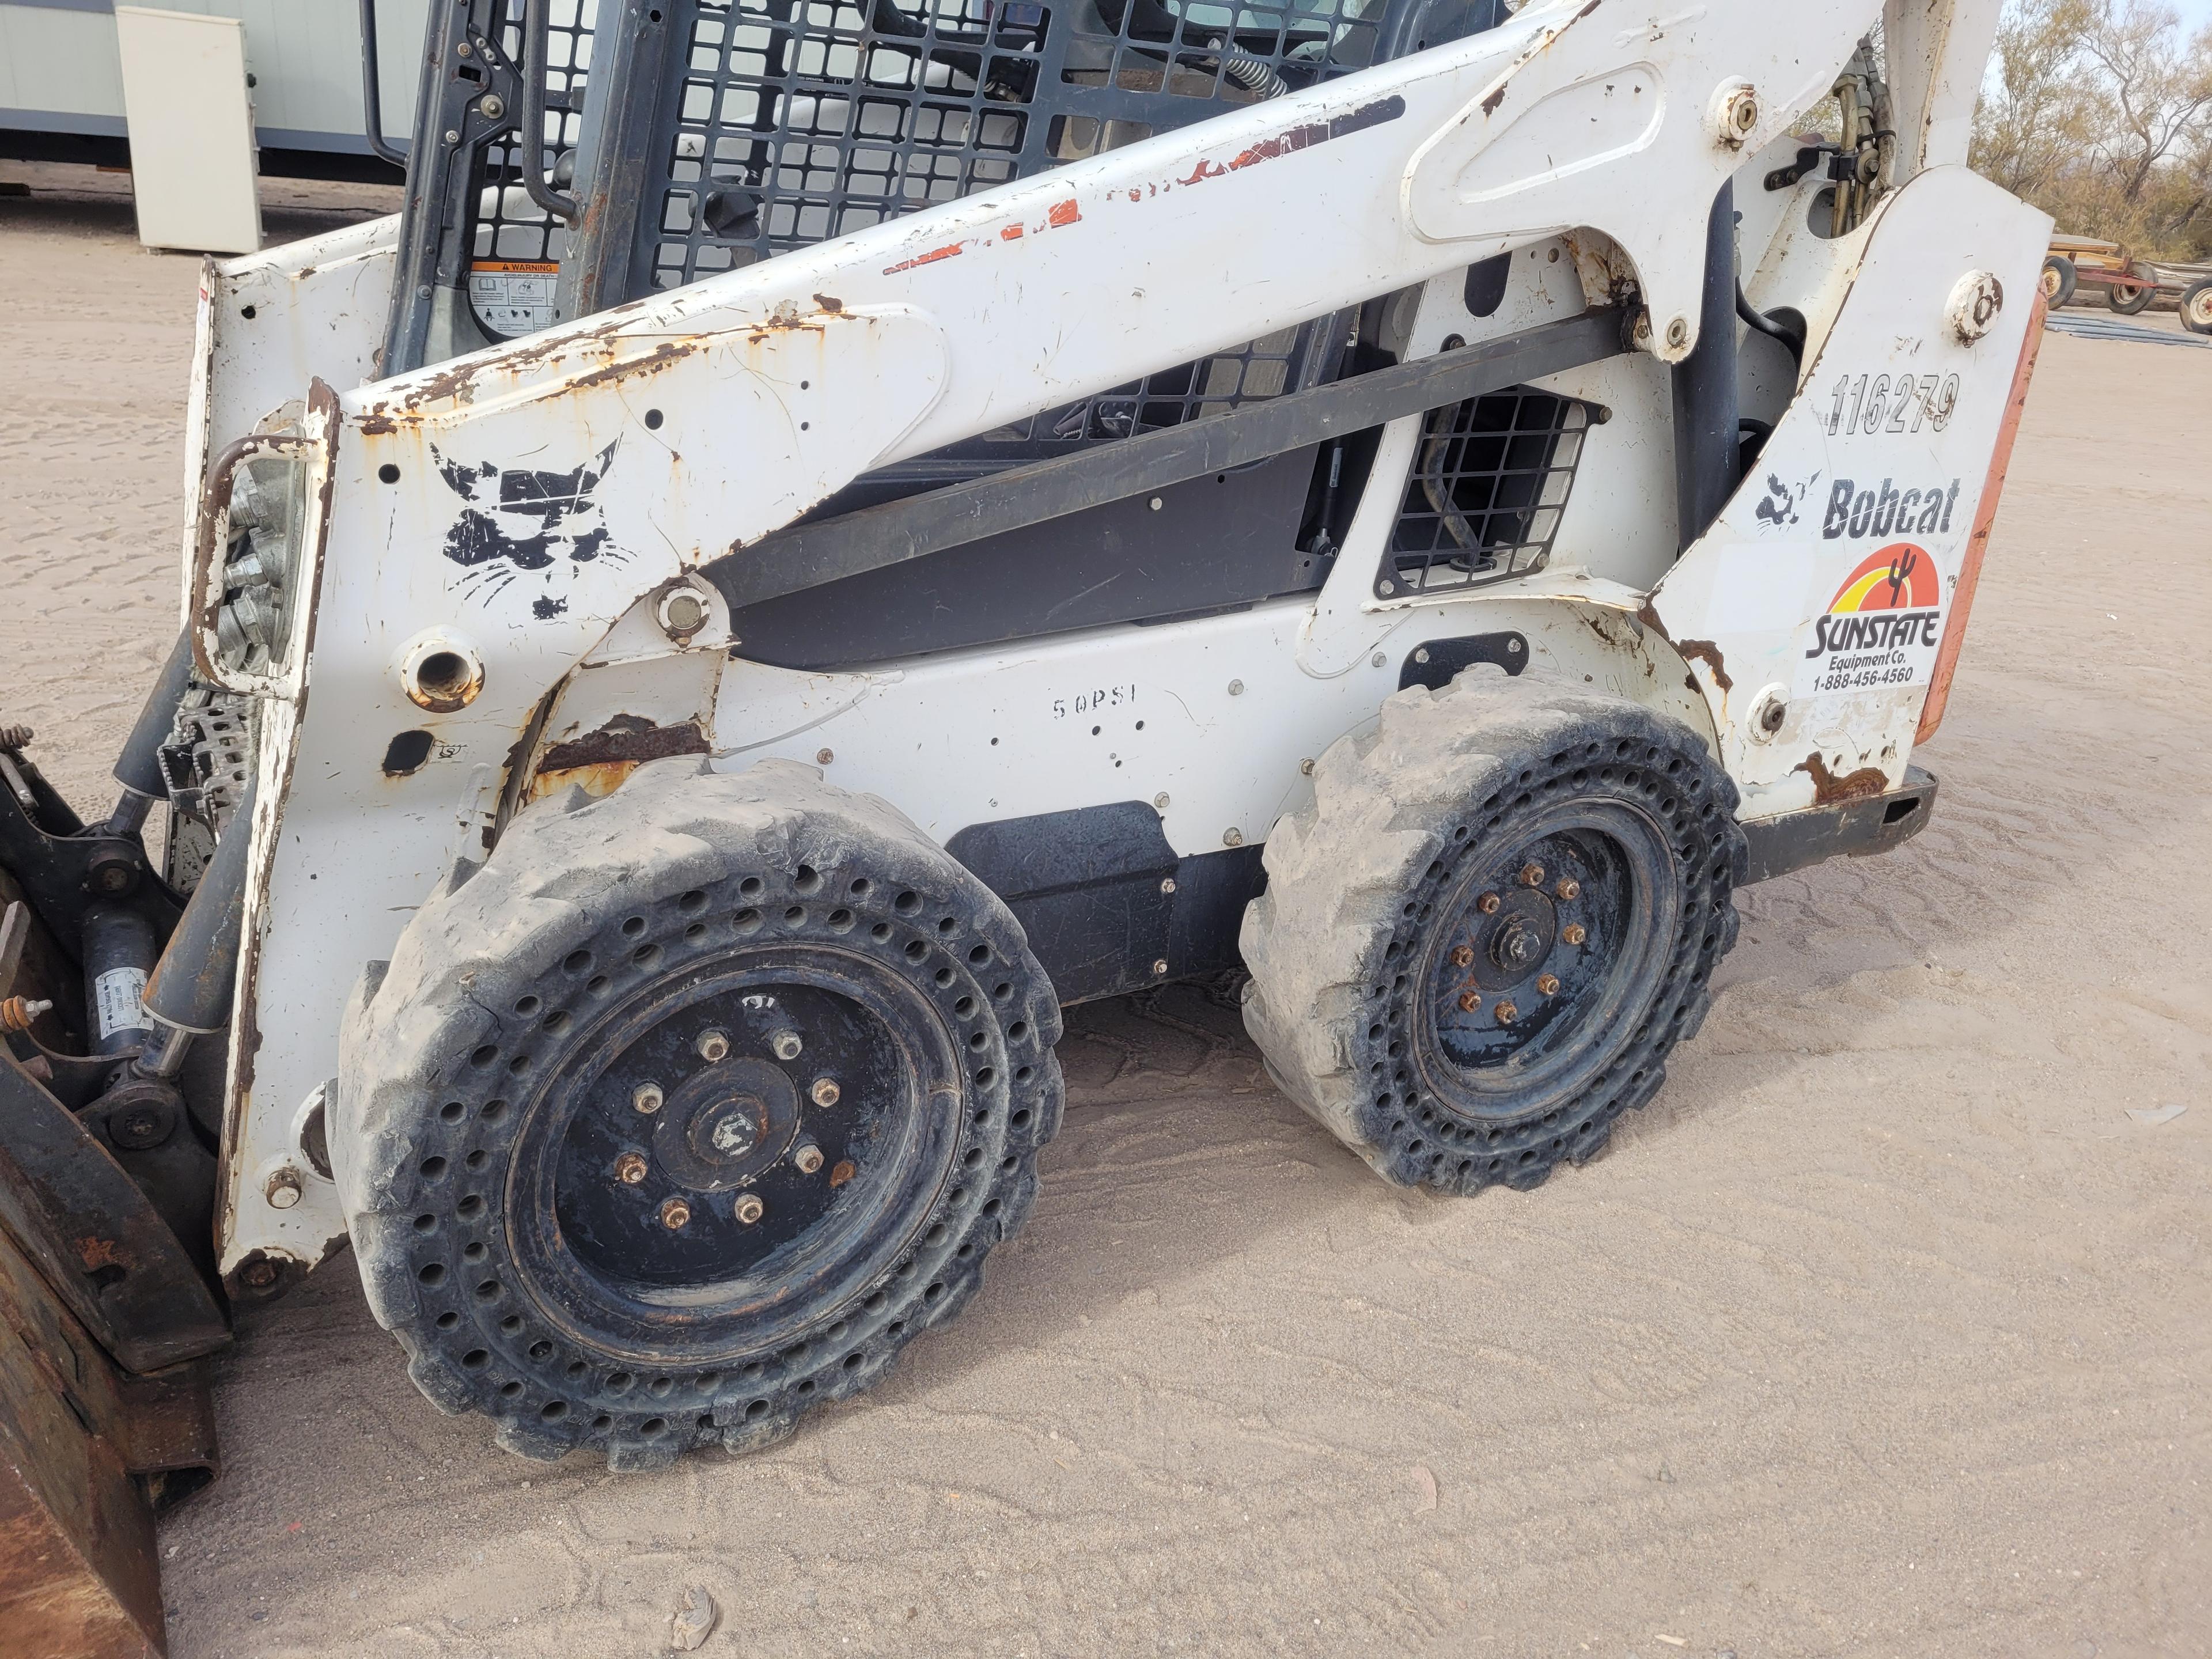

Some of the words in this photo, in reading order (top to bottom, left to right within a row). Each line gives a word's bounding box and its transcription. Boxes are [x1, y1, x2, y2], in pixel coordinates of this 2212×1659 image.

[1827, 373, 1960, 436] 116279
[1822, 477, 1961, 540] Bobcat
[1805, 610, 1940, 659] SUNSTATE
[1813, 666, 1914, 692] 1-888-456-4560
[1828, 652, 1890, 672] Equipment
[1891, 650, 1906, 665] Co.
